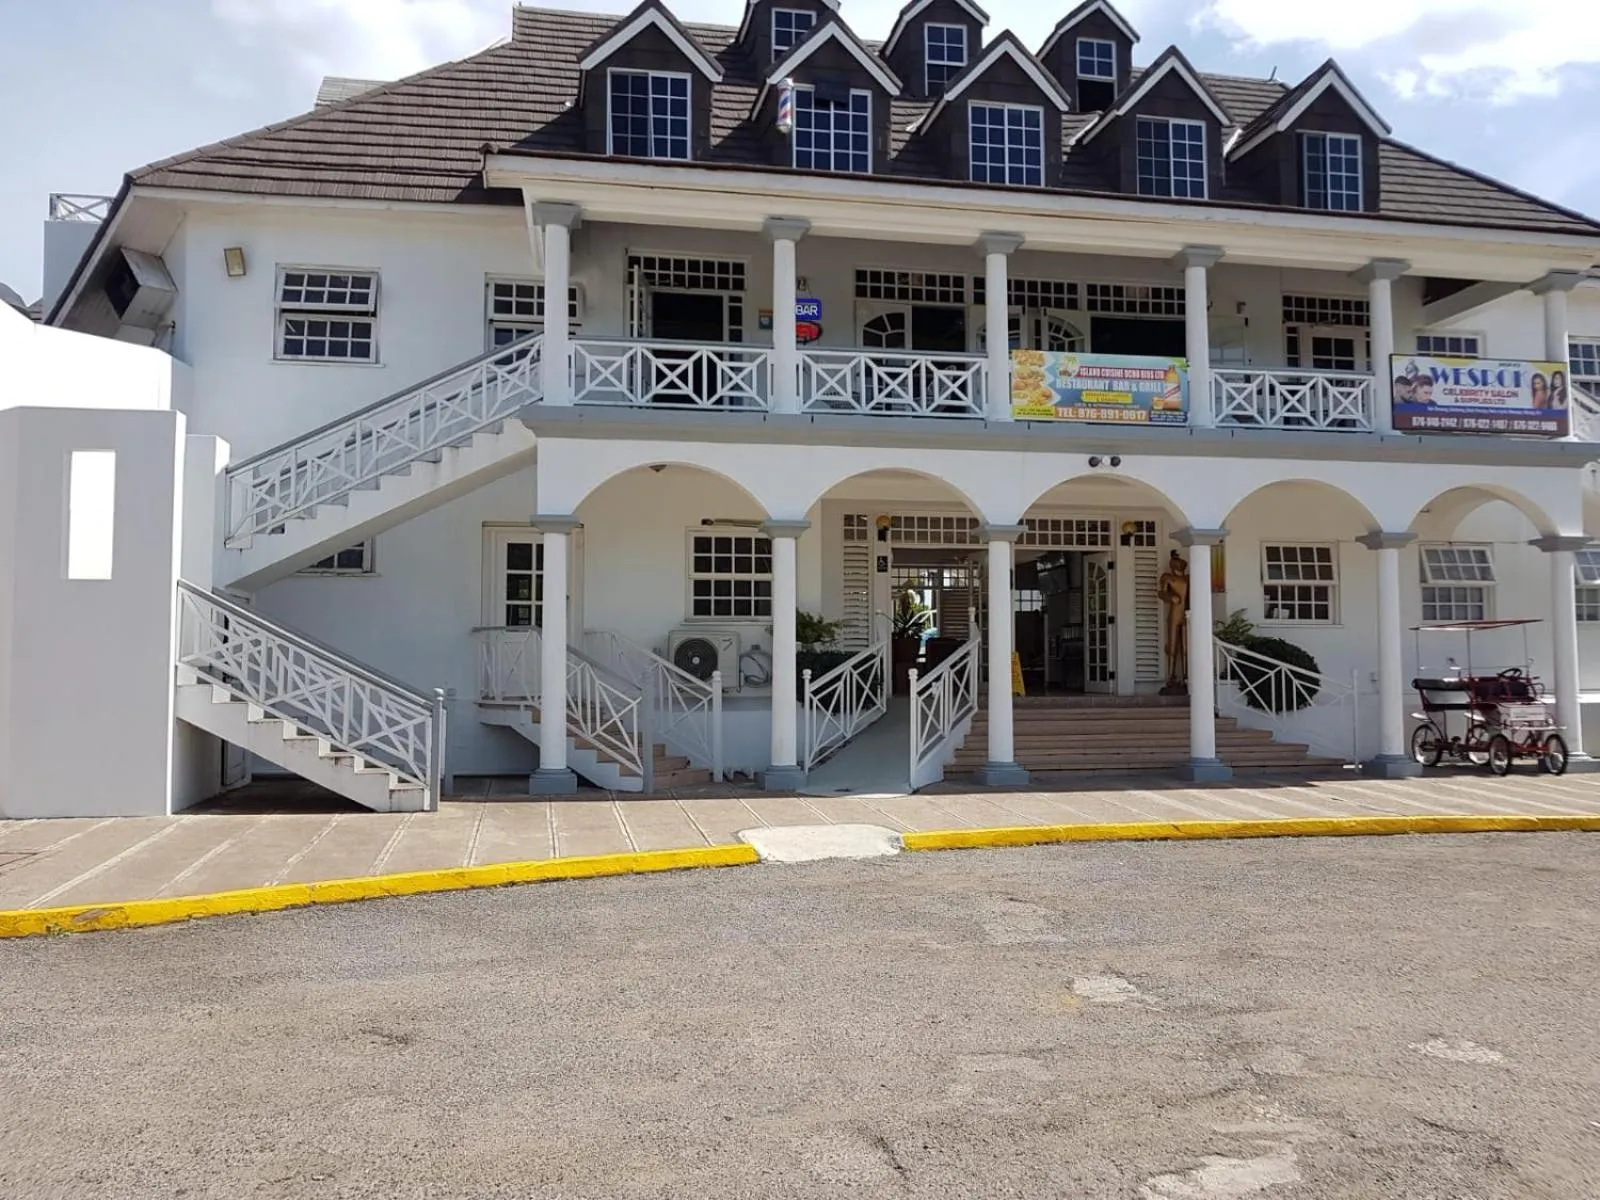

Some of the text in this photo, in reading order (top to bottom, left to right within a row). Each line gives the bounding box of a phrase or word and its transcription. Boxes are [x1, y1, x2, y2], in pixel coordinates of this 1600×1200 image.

[795, 304, 818, 317] BAR
[1079, 367, 1100, 377] ISLAND
[1101, 368, 1123, 378] CUISINE
[1112, 380, 1130, 392] BAR
[1139, 381, 1162, 394] GRILL
[1442, 387, 1519, 399] CELEBRITY SALON
